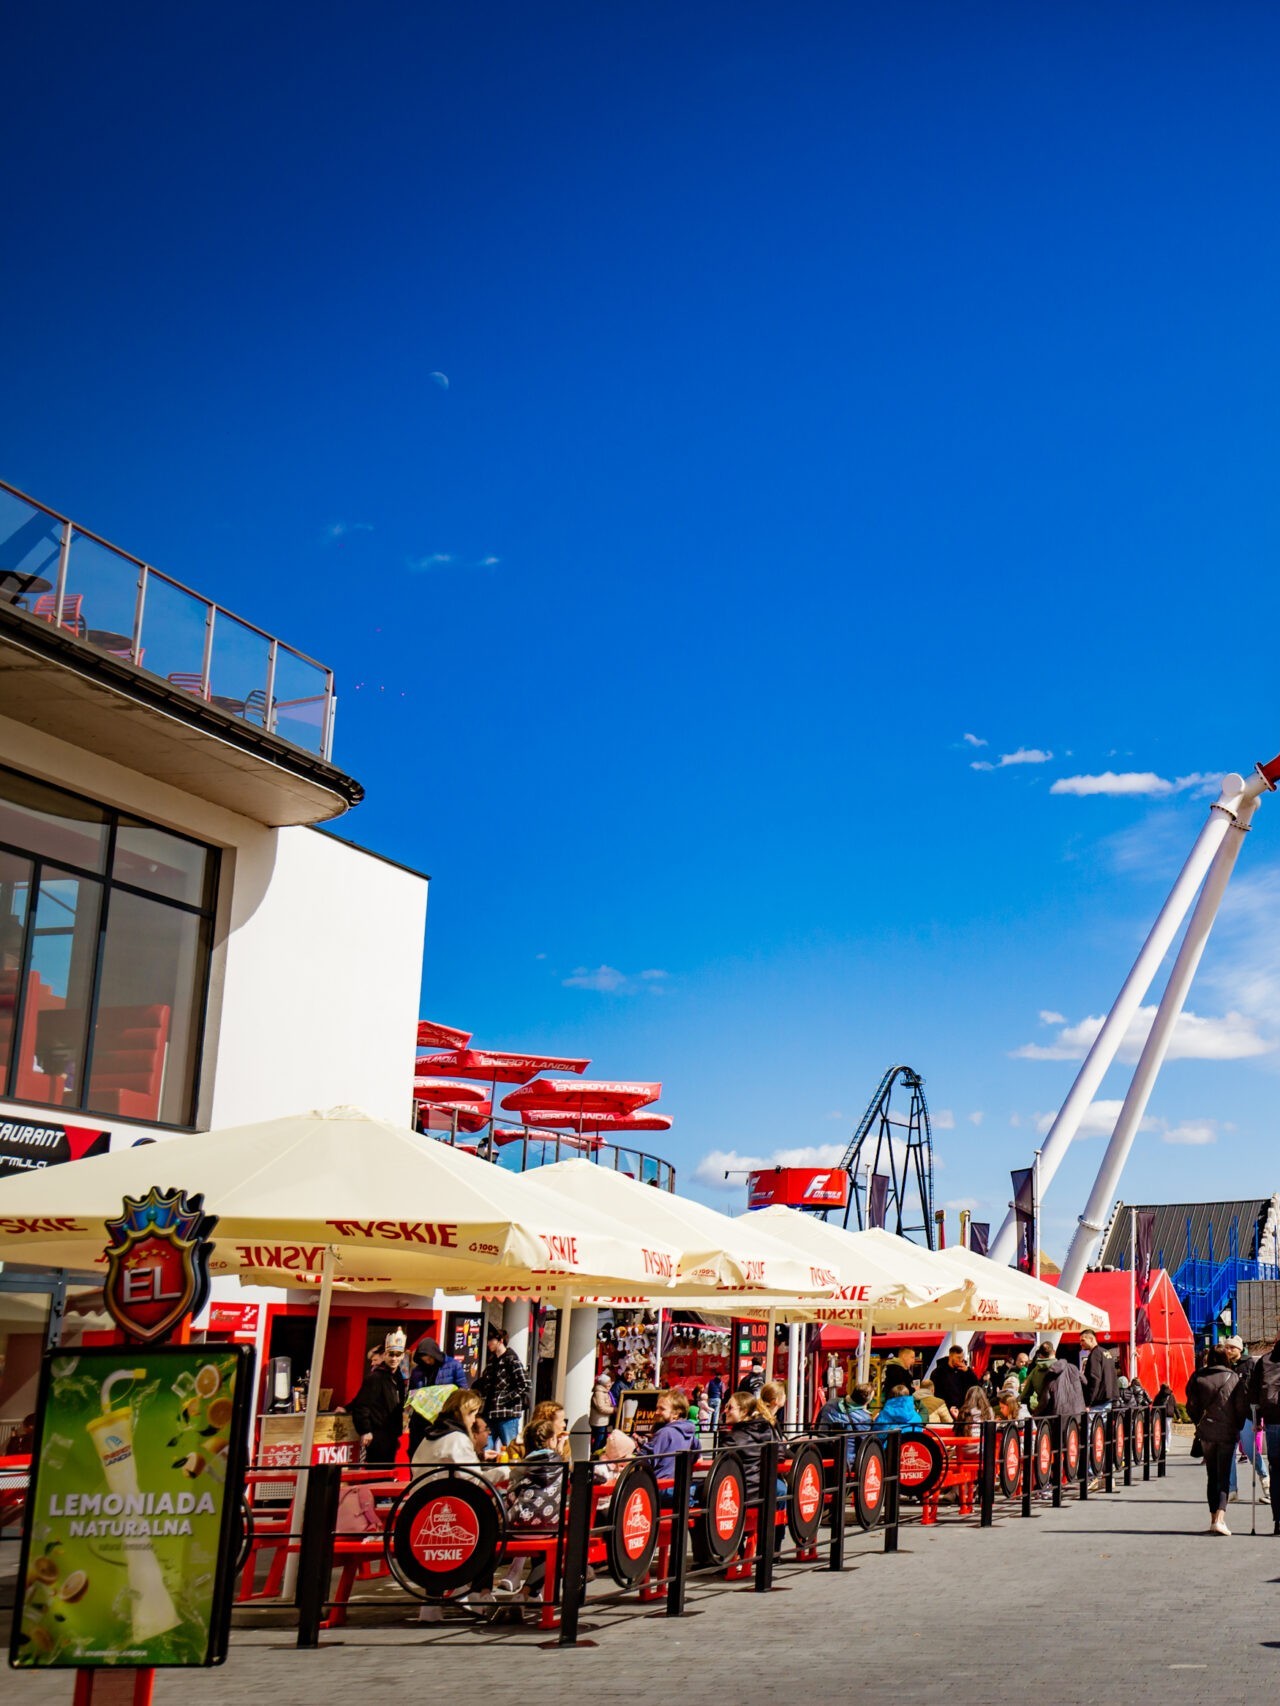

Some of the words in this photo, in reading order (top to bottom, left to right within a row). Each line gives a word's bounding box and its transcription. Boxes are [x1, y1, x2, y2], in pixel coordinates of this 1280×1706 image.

[481, 1057, 577, 1072] ENERGYLANDIA
[555, 1082, 651, 1096] ENERGYLANDIA
[531, 1110, 616, 1122] ENERGYLANDIA
[326, 1220, 458, 1248] TYSKIE
[480, 1243, 499, 1253] 100%
[123, 1265, 182, 1304] EL
[752, 1324, 767, 1337] 0.00
[751, 1340, 767, 1353] 0.00
[636, 1410, 656, 1420] PIW
[317, 1445, 354, 1464] TYSKIE
[49, 1492, 216, 1517] LEMONIADA
[70, 1519, 193, 1538] NATURALNA
[423, 1548, 464, 1561] TYSKIE
